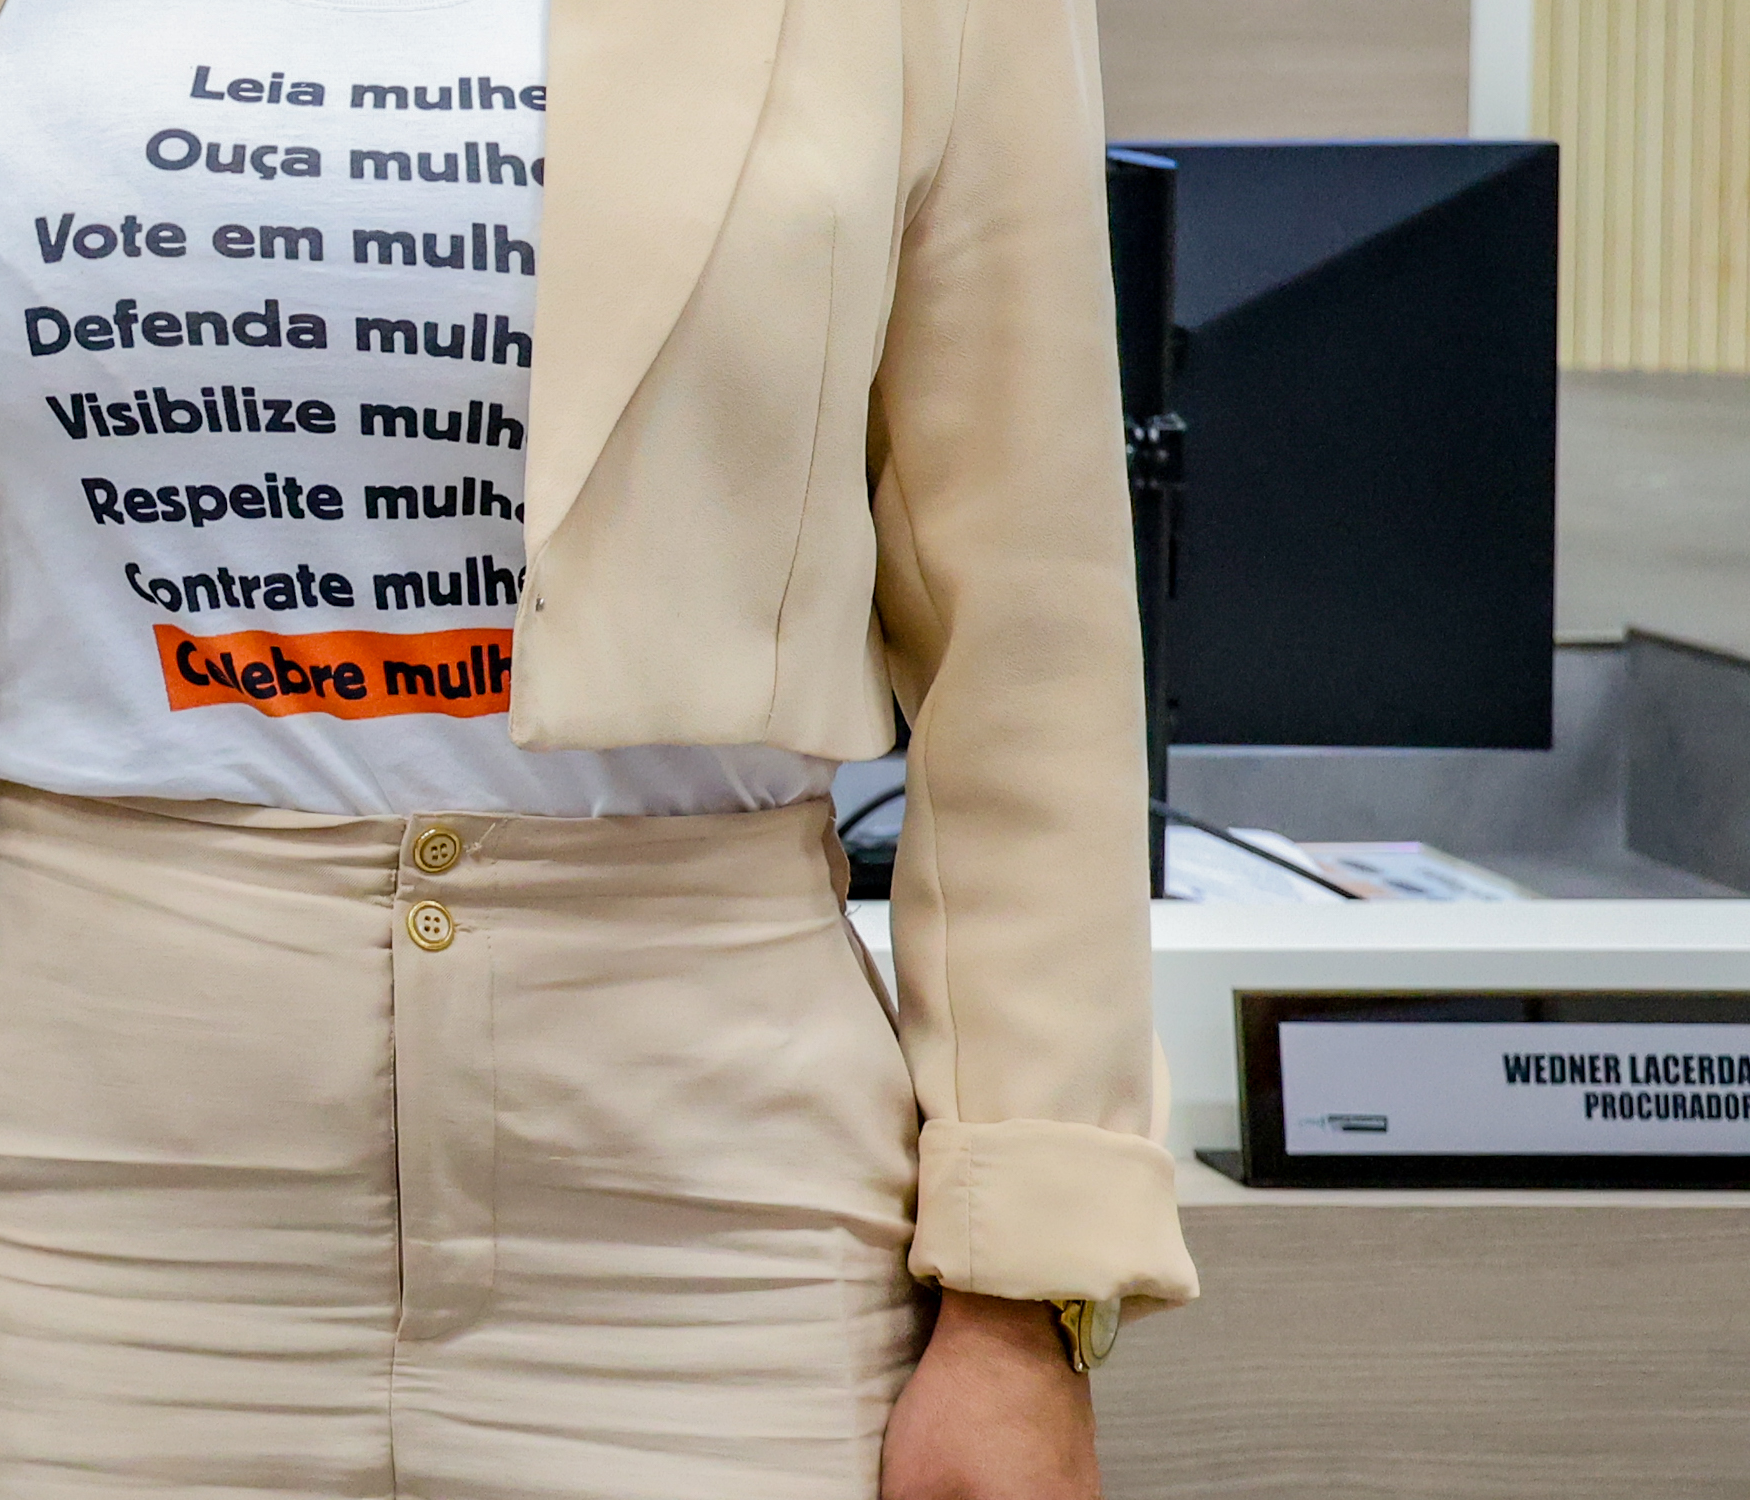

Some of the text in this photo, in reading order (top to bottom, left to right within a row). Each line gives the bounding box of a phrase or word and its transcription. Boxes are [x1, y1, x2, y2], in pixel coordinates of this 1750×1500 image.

[190, 65, 547, 113] Leia mulhe
[146, 128, 321, 181] Ouça
[35, 213, 536, 276] Vote em mulh
[25, 299, 533, 368] Defenda mulh
[46, 386, 336, 440] Visibilize
[81, 473, 343, 527] Respeite
[125, 562, 354, 612] Contrate
[1504, 1054, 1750, 1086] WEDNER LACERDA
